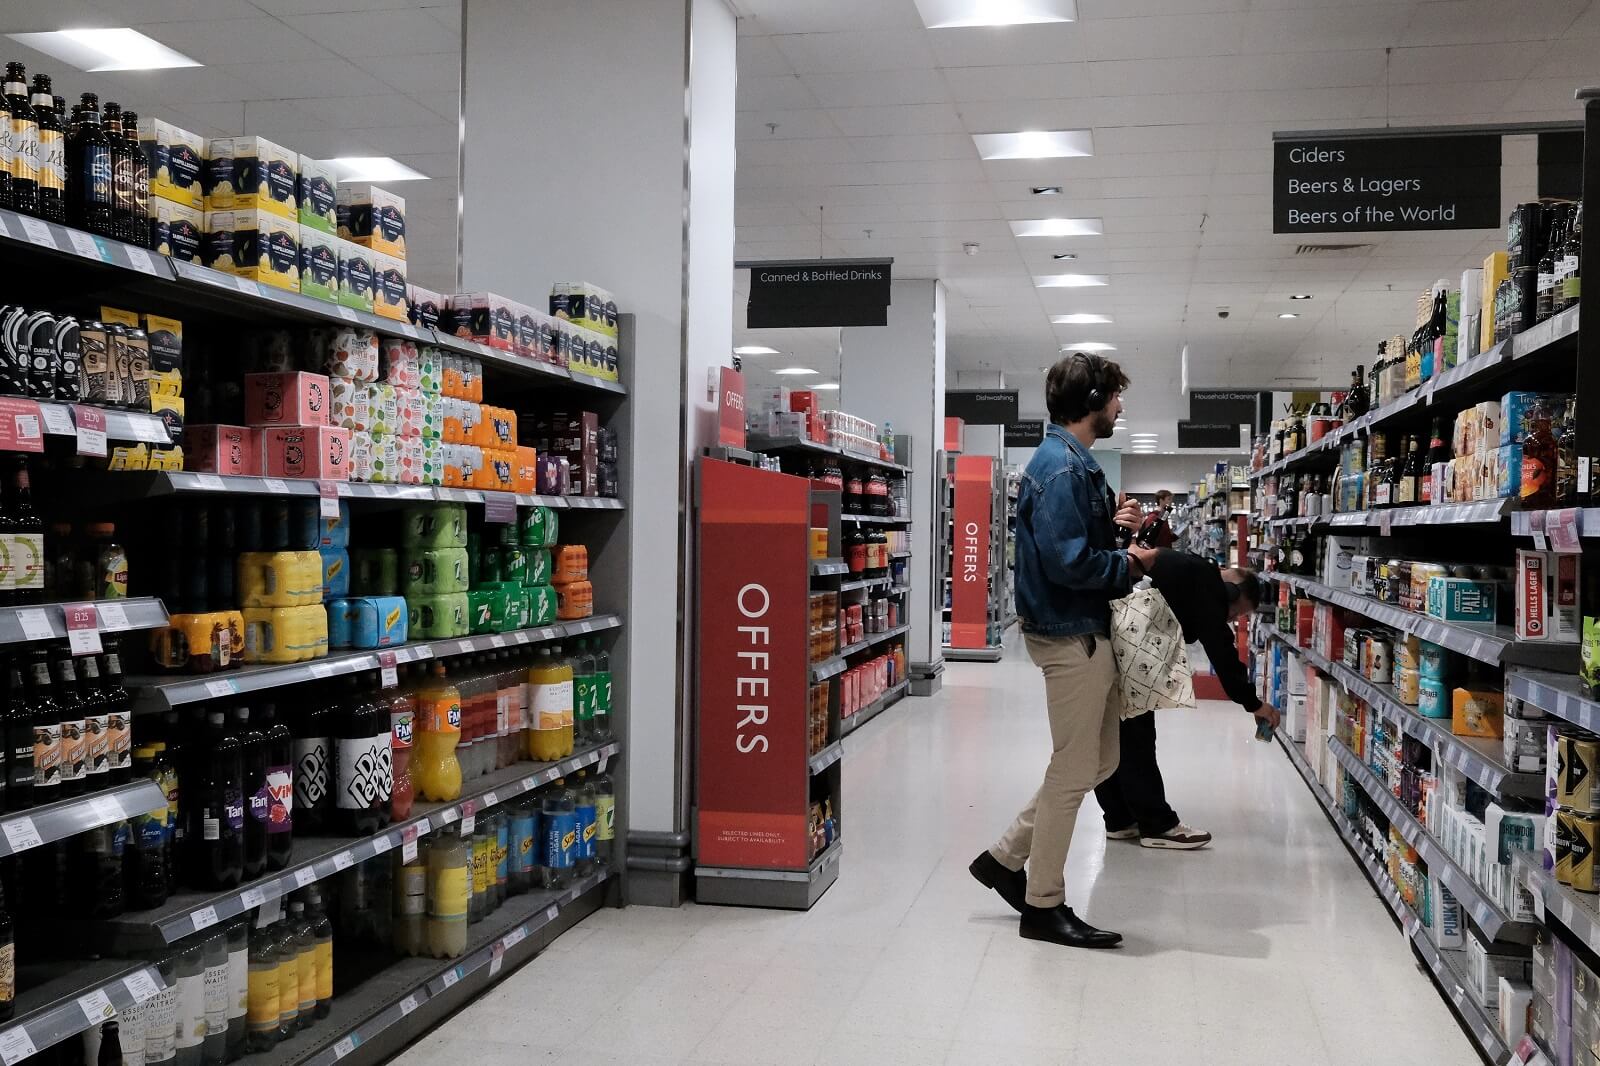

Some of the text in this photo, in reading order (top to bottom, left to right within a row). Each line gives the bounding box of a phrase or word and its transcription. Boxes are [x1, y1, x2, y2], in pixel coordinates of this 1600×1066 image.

[1289, 147, 1345, 163] Ciders
[1288, 176, 1421, 196] Beers & Lagers
[1288, 204, 1456, 224] Beers of the World
[760, 269, 882, 283] Canned & Bottled Drinks
[726, 390, 745, 411] OFFERS
[963, 522, 978, 582] OFFERS
[1529, 571, 1538, 594] LAGER
[1461, 589, 1481, 614] PALE
[1529, 595, 1538, 618] HELLS
[736, 583, 770, 753] OFFERS
[1443, 906, 1459, 936] PUNK
